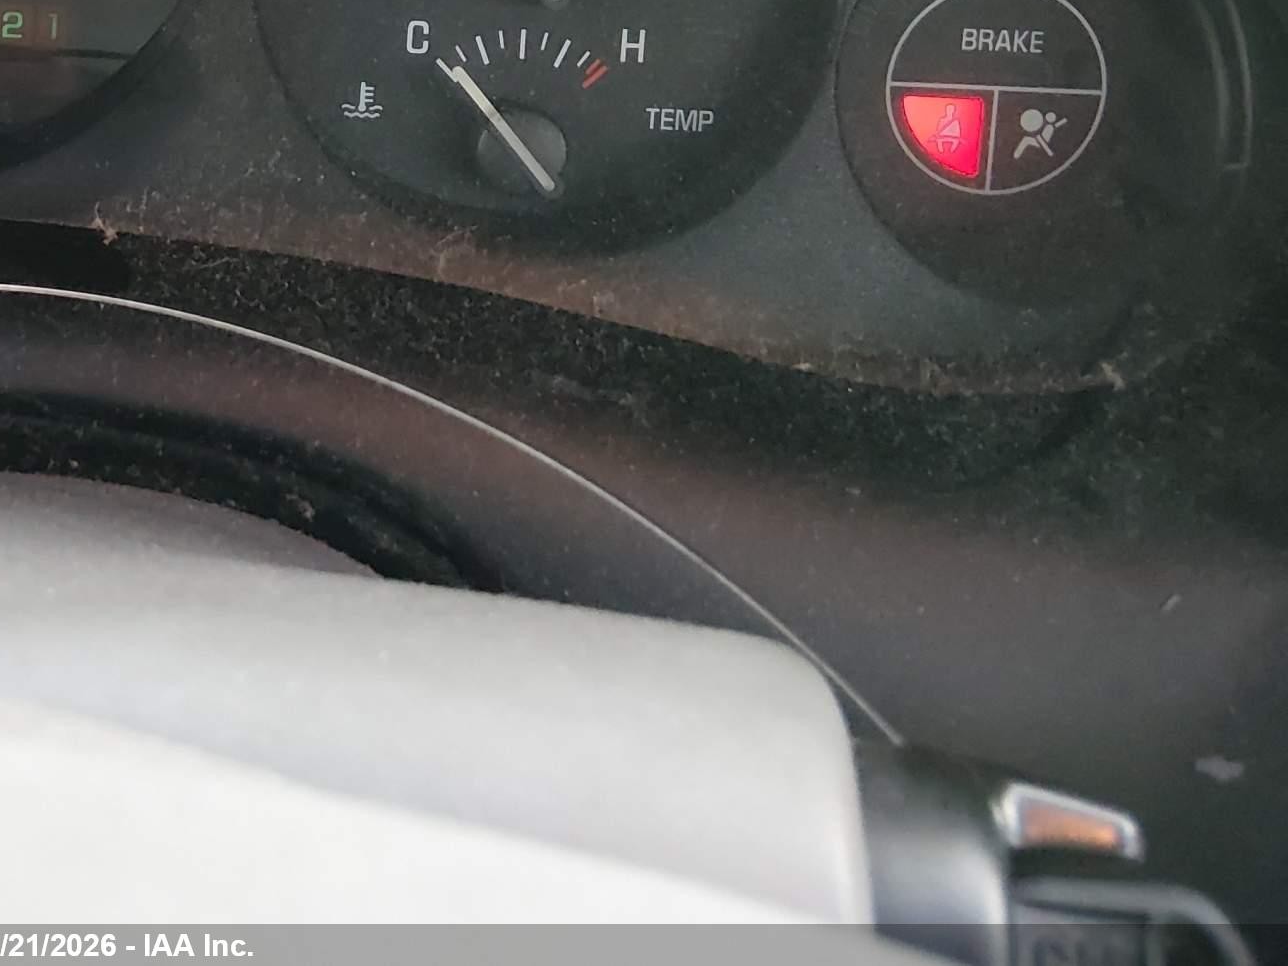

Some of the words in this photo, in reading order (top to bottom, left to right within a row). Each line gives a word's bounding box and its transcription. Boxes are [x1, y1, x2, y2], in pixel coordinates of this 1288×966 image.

[1, 11, 23, 39] 2
[406, 21, 430, 55] C
[619, 29, 646, 63] H
[961, 28, 1045, 53] BRAKE
[646, 108, 714, 132] TEMP
